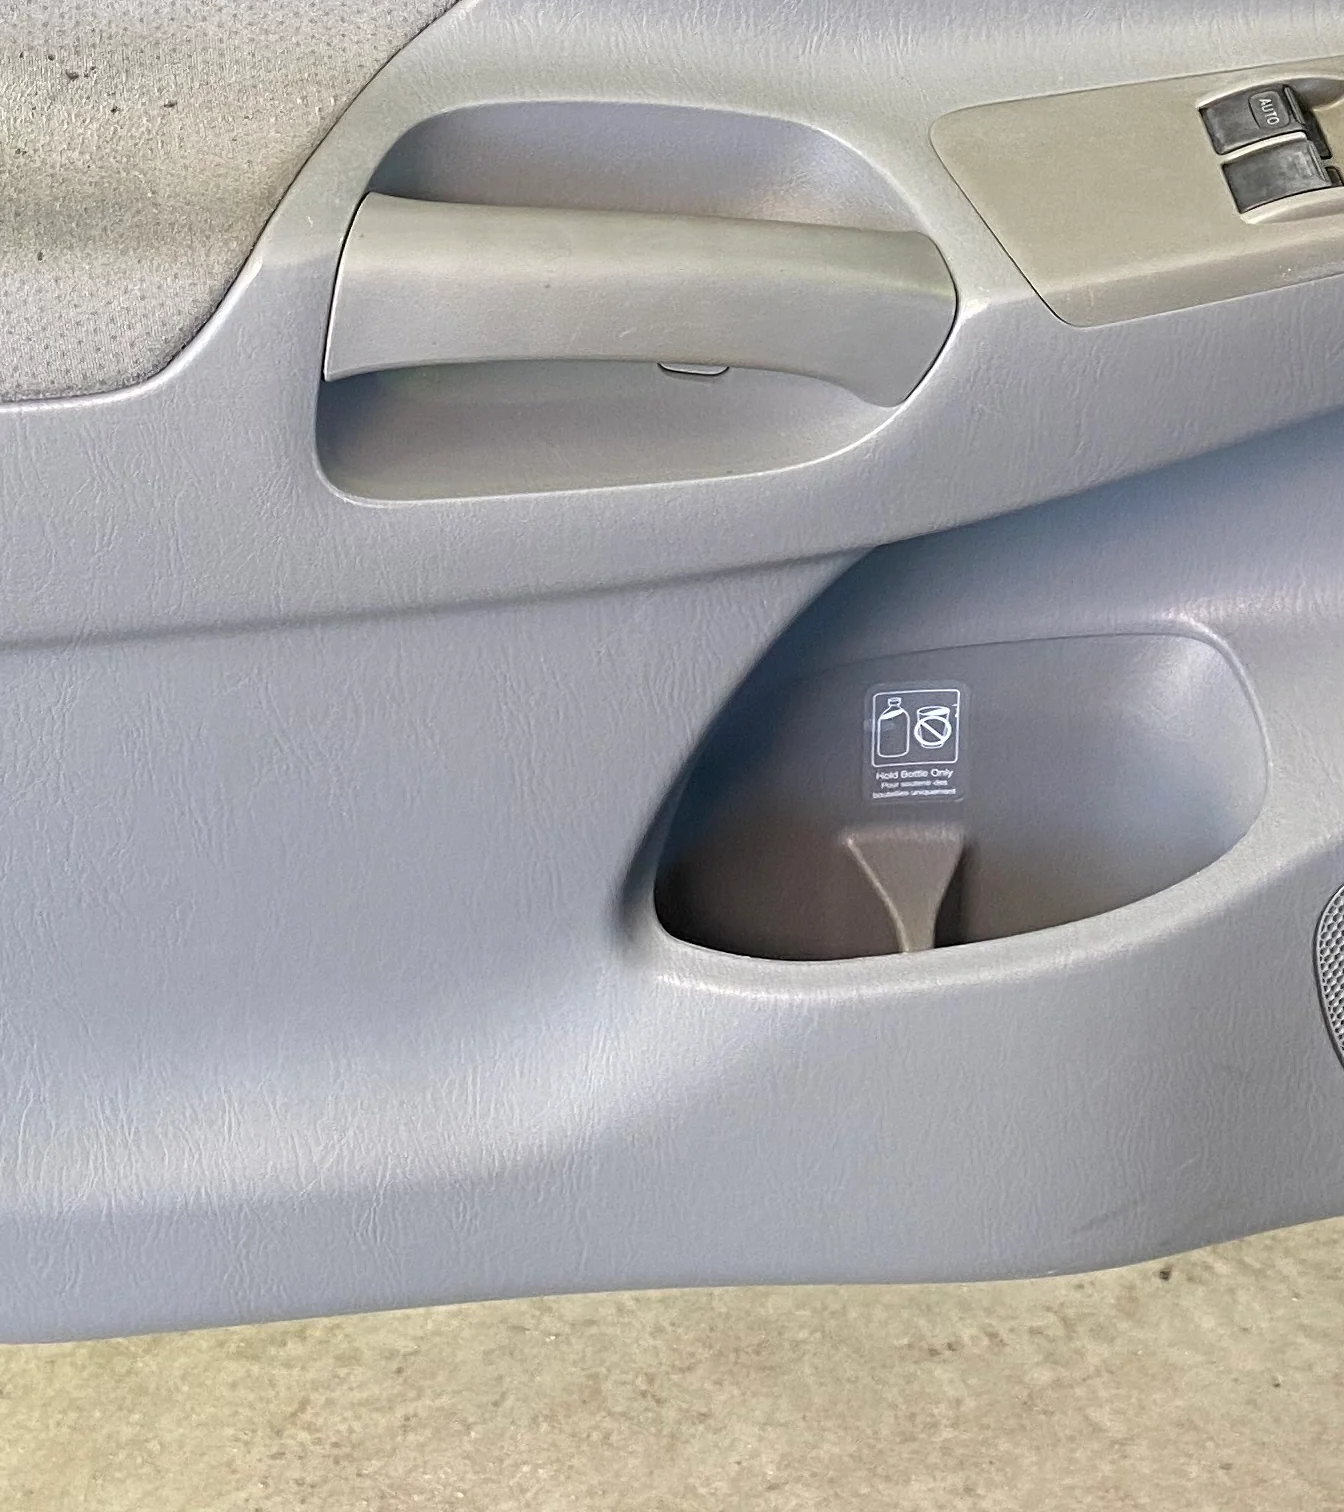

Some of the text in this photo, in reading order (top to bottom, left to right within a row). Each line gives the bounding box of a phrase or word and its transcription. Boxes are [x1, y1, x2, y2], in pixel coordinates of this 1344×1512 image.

[1259, 99, 1280, 125] AUTO
[876, 768, 954, 779] Hold Bottle Only
